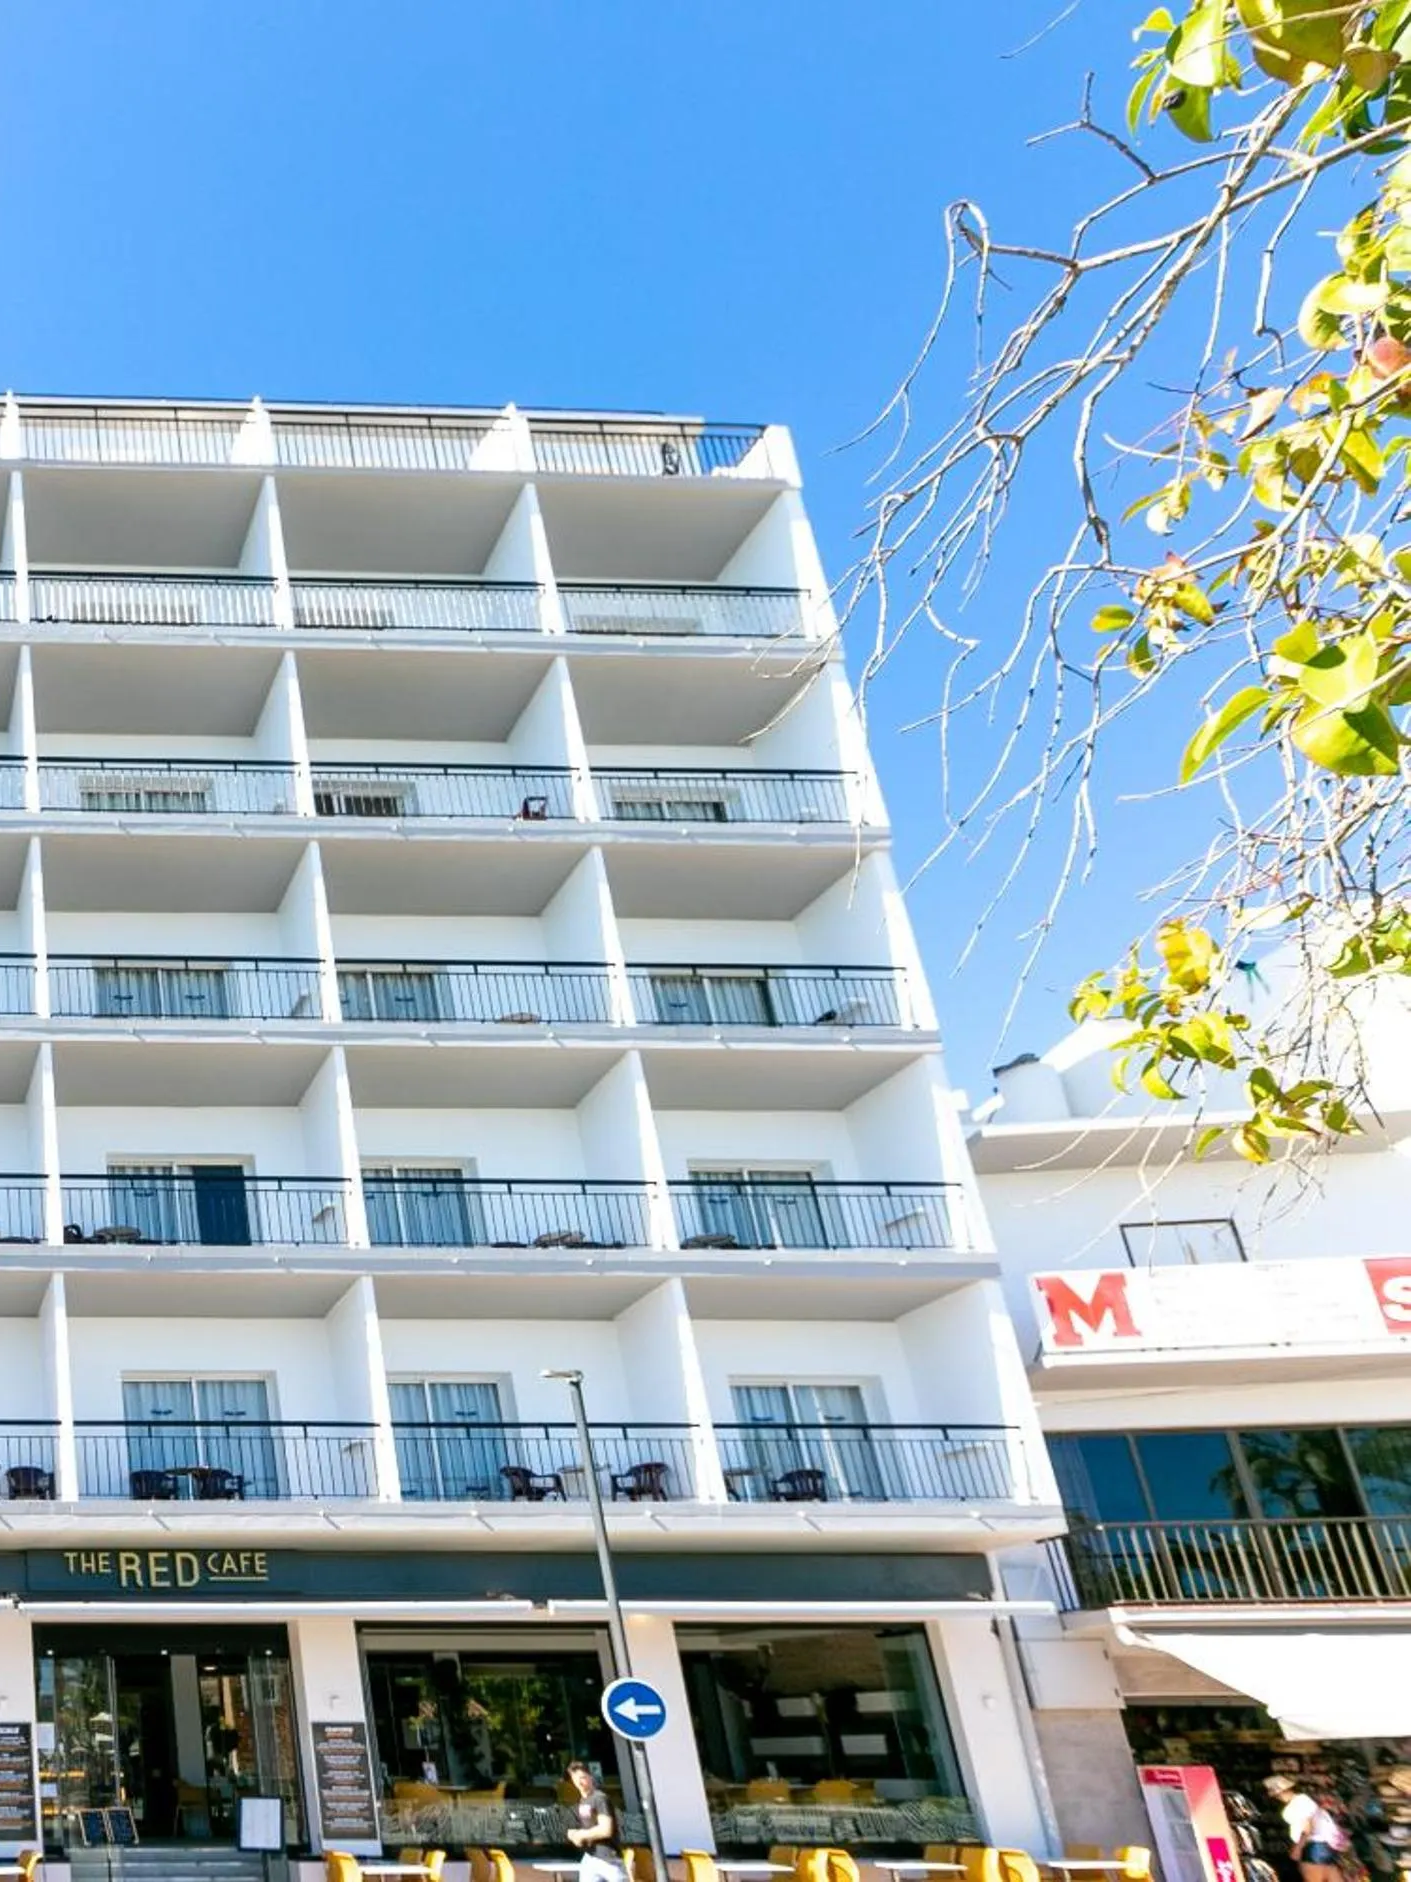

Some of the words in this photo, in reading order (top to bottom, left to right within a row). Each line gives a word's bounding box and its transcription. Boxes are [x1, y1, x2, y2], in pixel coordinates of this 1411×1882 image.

[63, 1552, 111, 1574] THE
[119, 1551, 200, 1588] RED
[207, 1552, 269, 1574] CAFE
